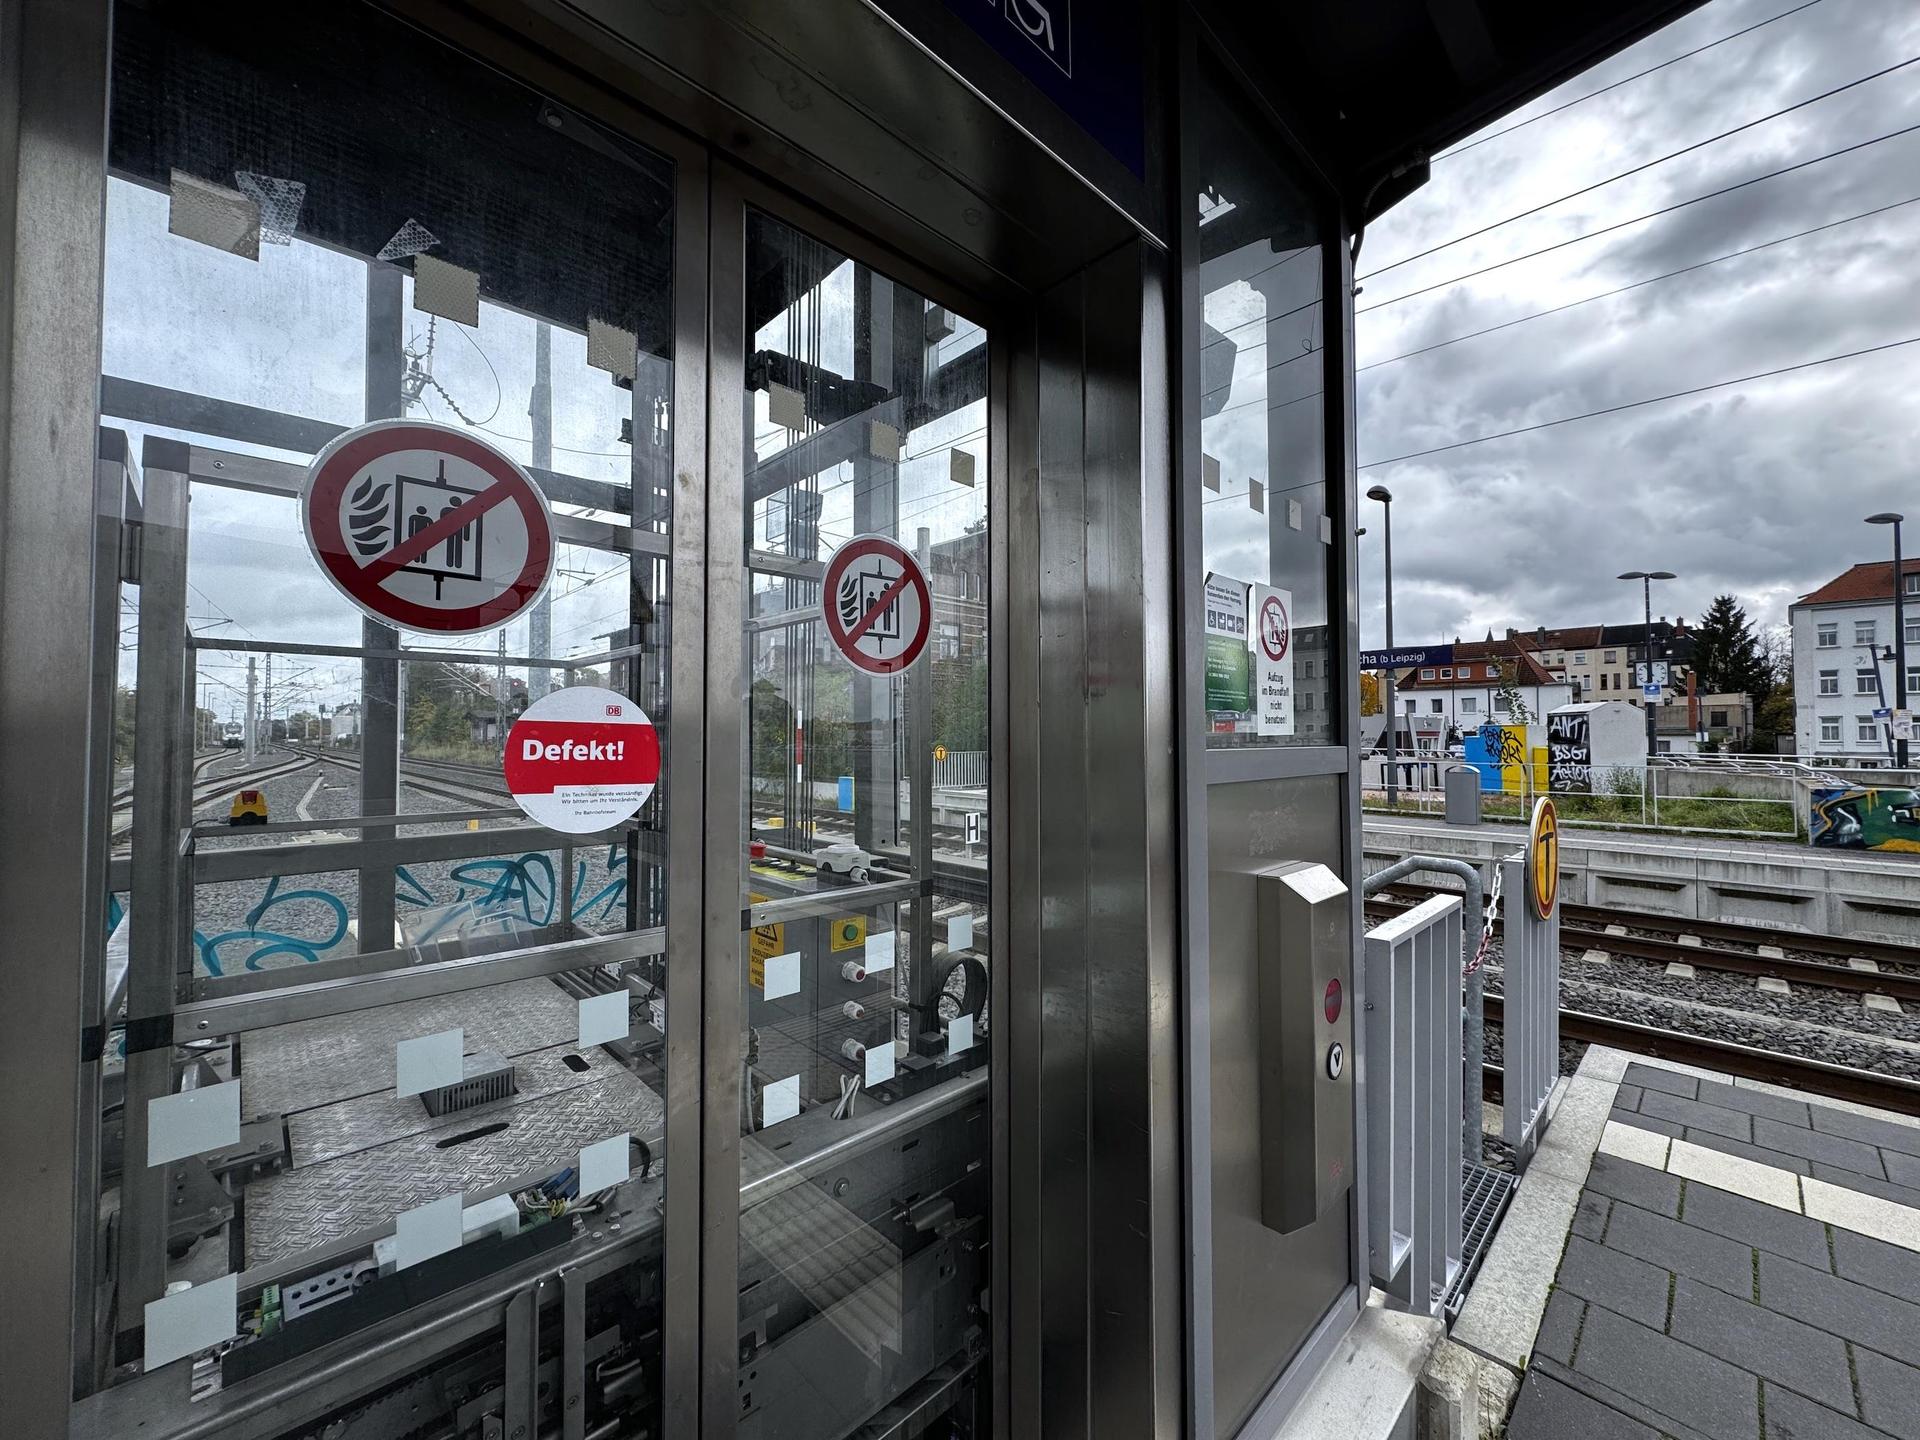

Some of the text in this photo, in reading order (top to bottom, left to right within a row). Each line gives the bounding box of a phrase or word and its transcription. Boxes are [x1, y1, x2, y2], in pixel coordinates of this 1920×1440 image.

[1380, 653, 1389, 664] (b
[1390, 651, 1426, 664] Leipzig)
[1268, 671, 1283, 685] Aufzug
[1261, 685, 1290, 697] im Brandfall
[607, 706, 620, 715] DB
[1270, 700, 1282, 710] nicht
[522, 739, 625, 761] Defekt!
[966, 814, 980, 842] H
